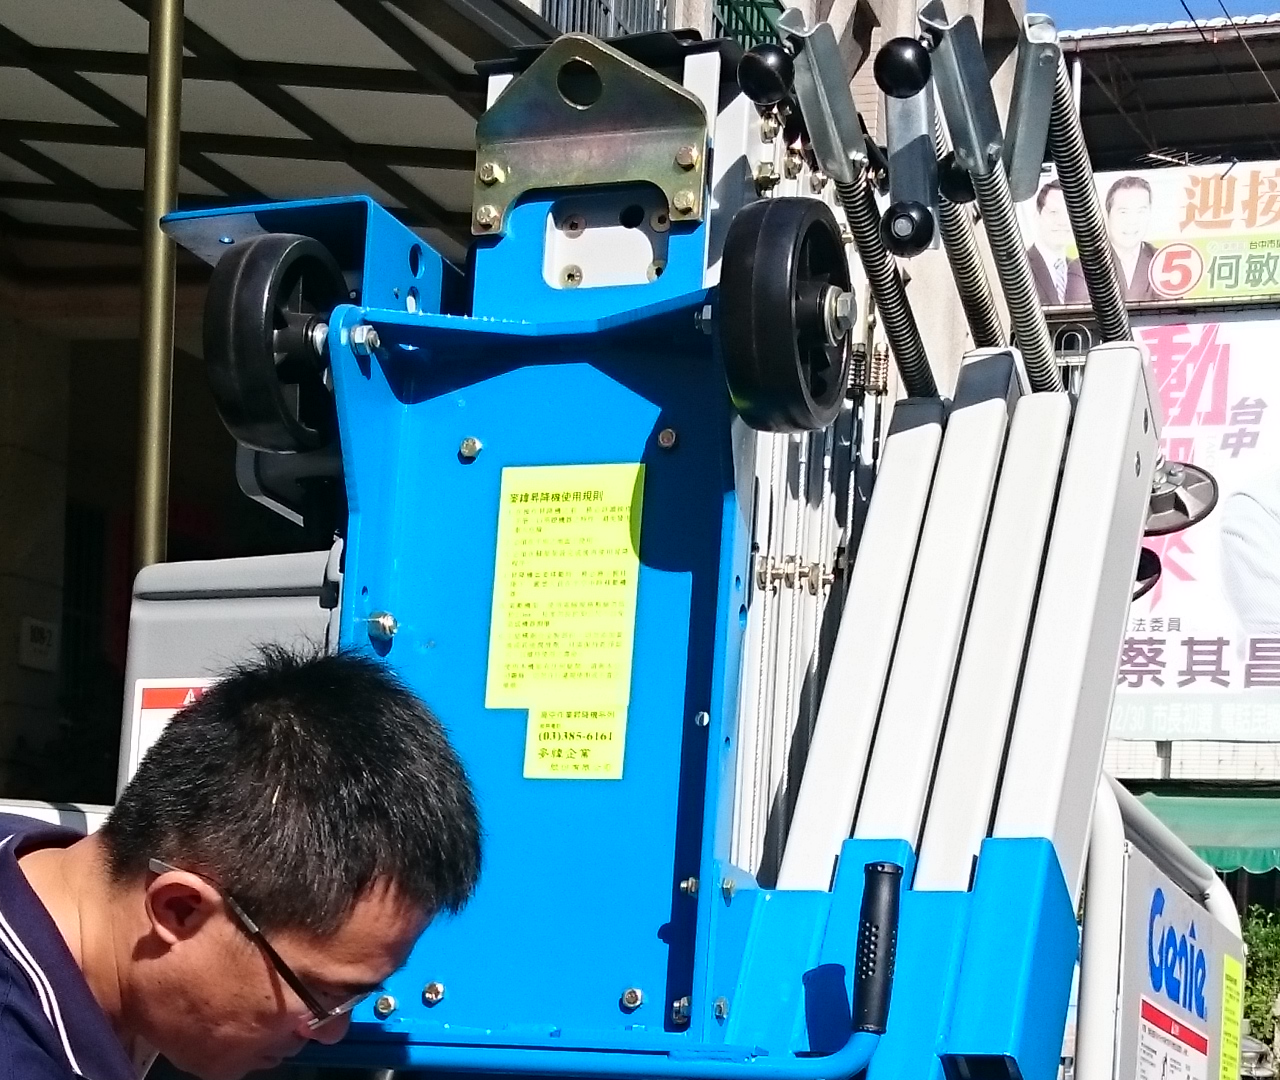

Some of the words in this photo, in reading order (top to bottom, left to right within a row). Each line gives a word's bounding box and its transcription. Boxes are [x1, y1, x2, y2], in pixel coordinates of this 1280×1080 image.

[1159, 250, 1193, 292] 5
[1220, 396, 1269, 459] 台中
[1125, 617, 1182, 633] 法委員
[1148, 887, 1207, 1013] Genie
